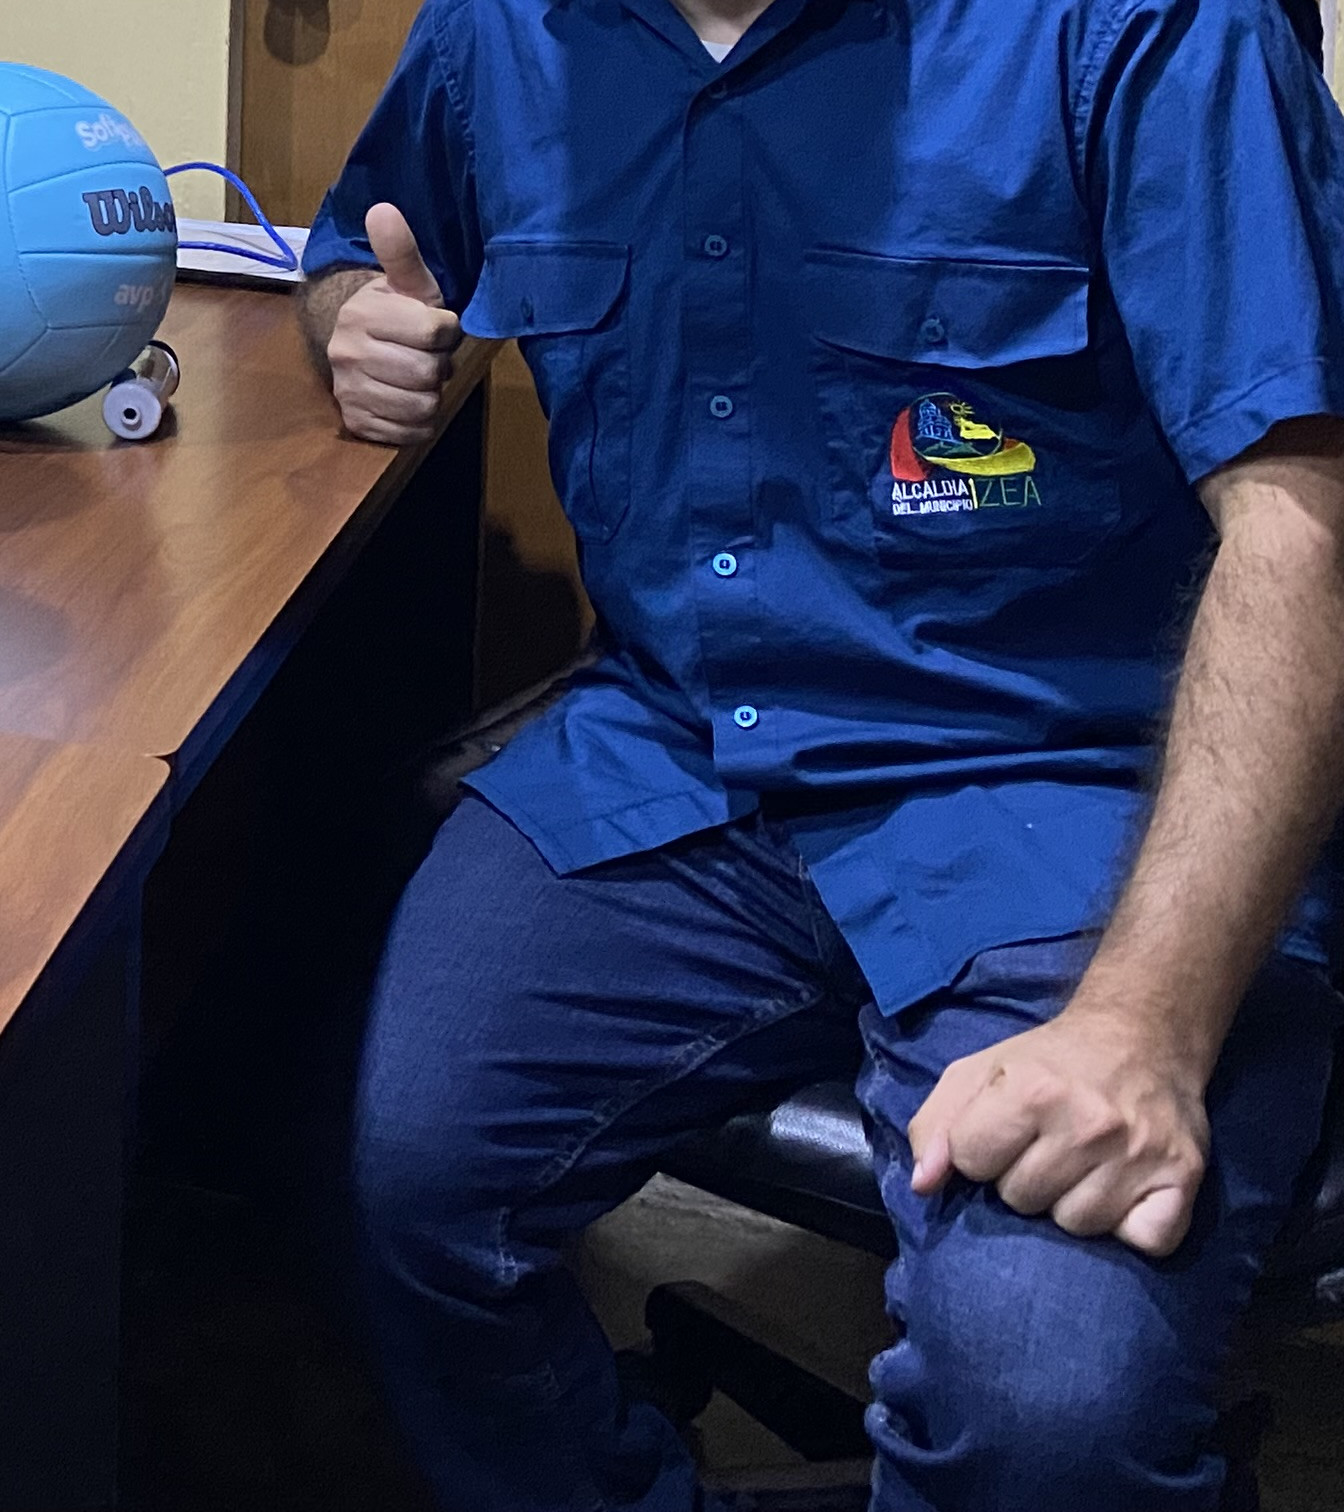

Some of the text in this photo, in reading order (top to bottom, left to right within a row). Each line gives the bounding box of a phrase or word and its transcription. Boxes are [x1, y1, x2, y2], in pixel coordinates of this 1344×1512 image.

[81, 186, 177, 237] Wilso
[891, 478, 970, 501] ALCALDIA
[976, 475, 1042, 507] ZEA
[919, 498, 974, 514] MUNICIPIO
